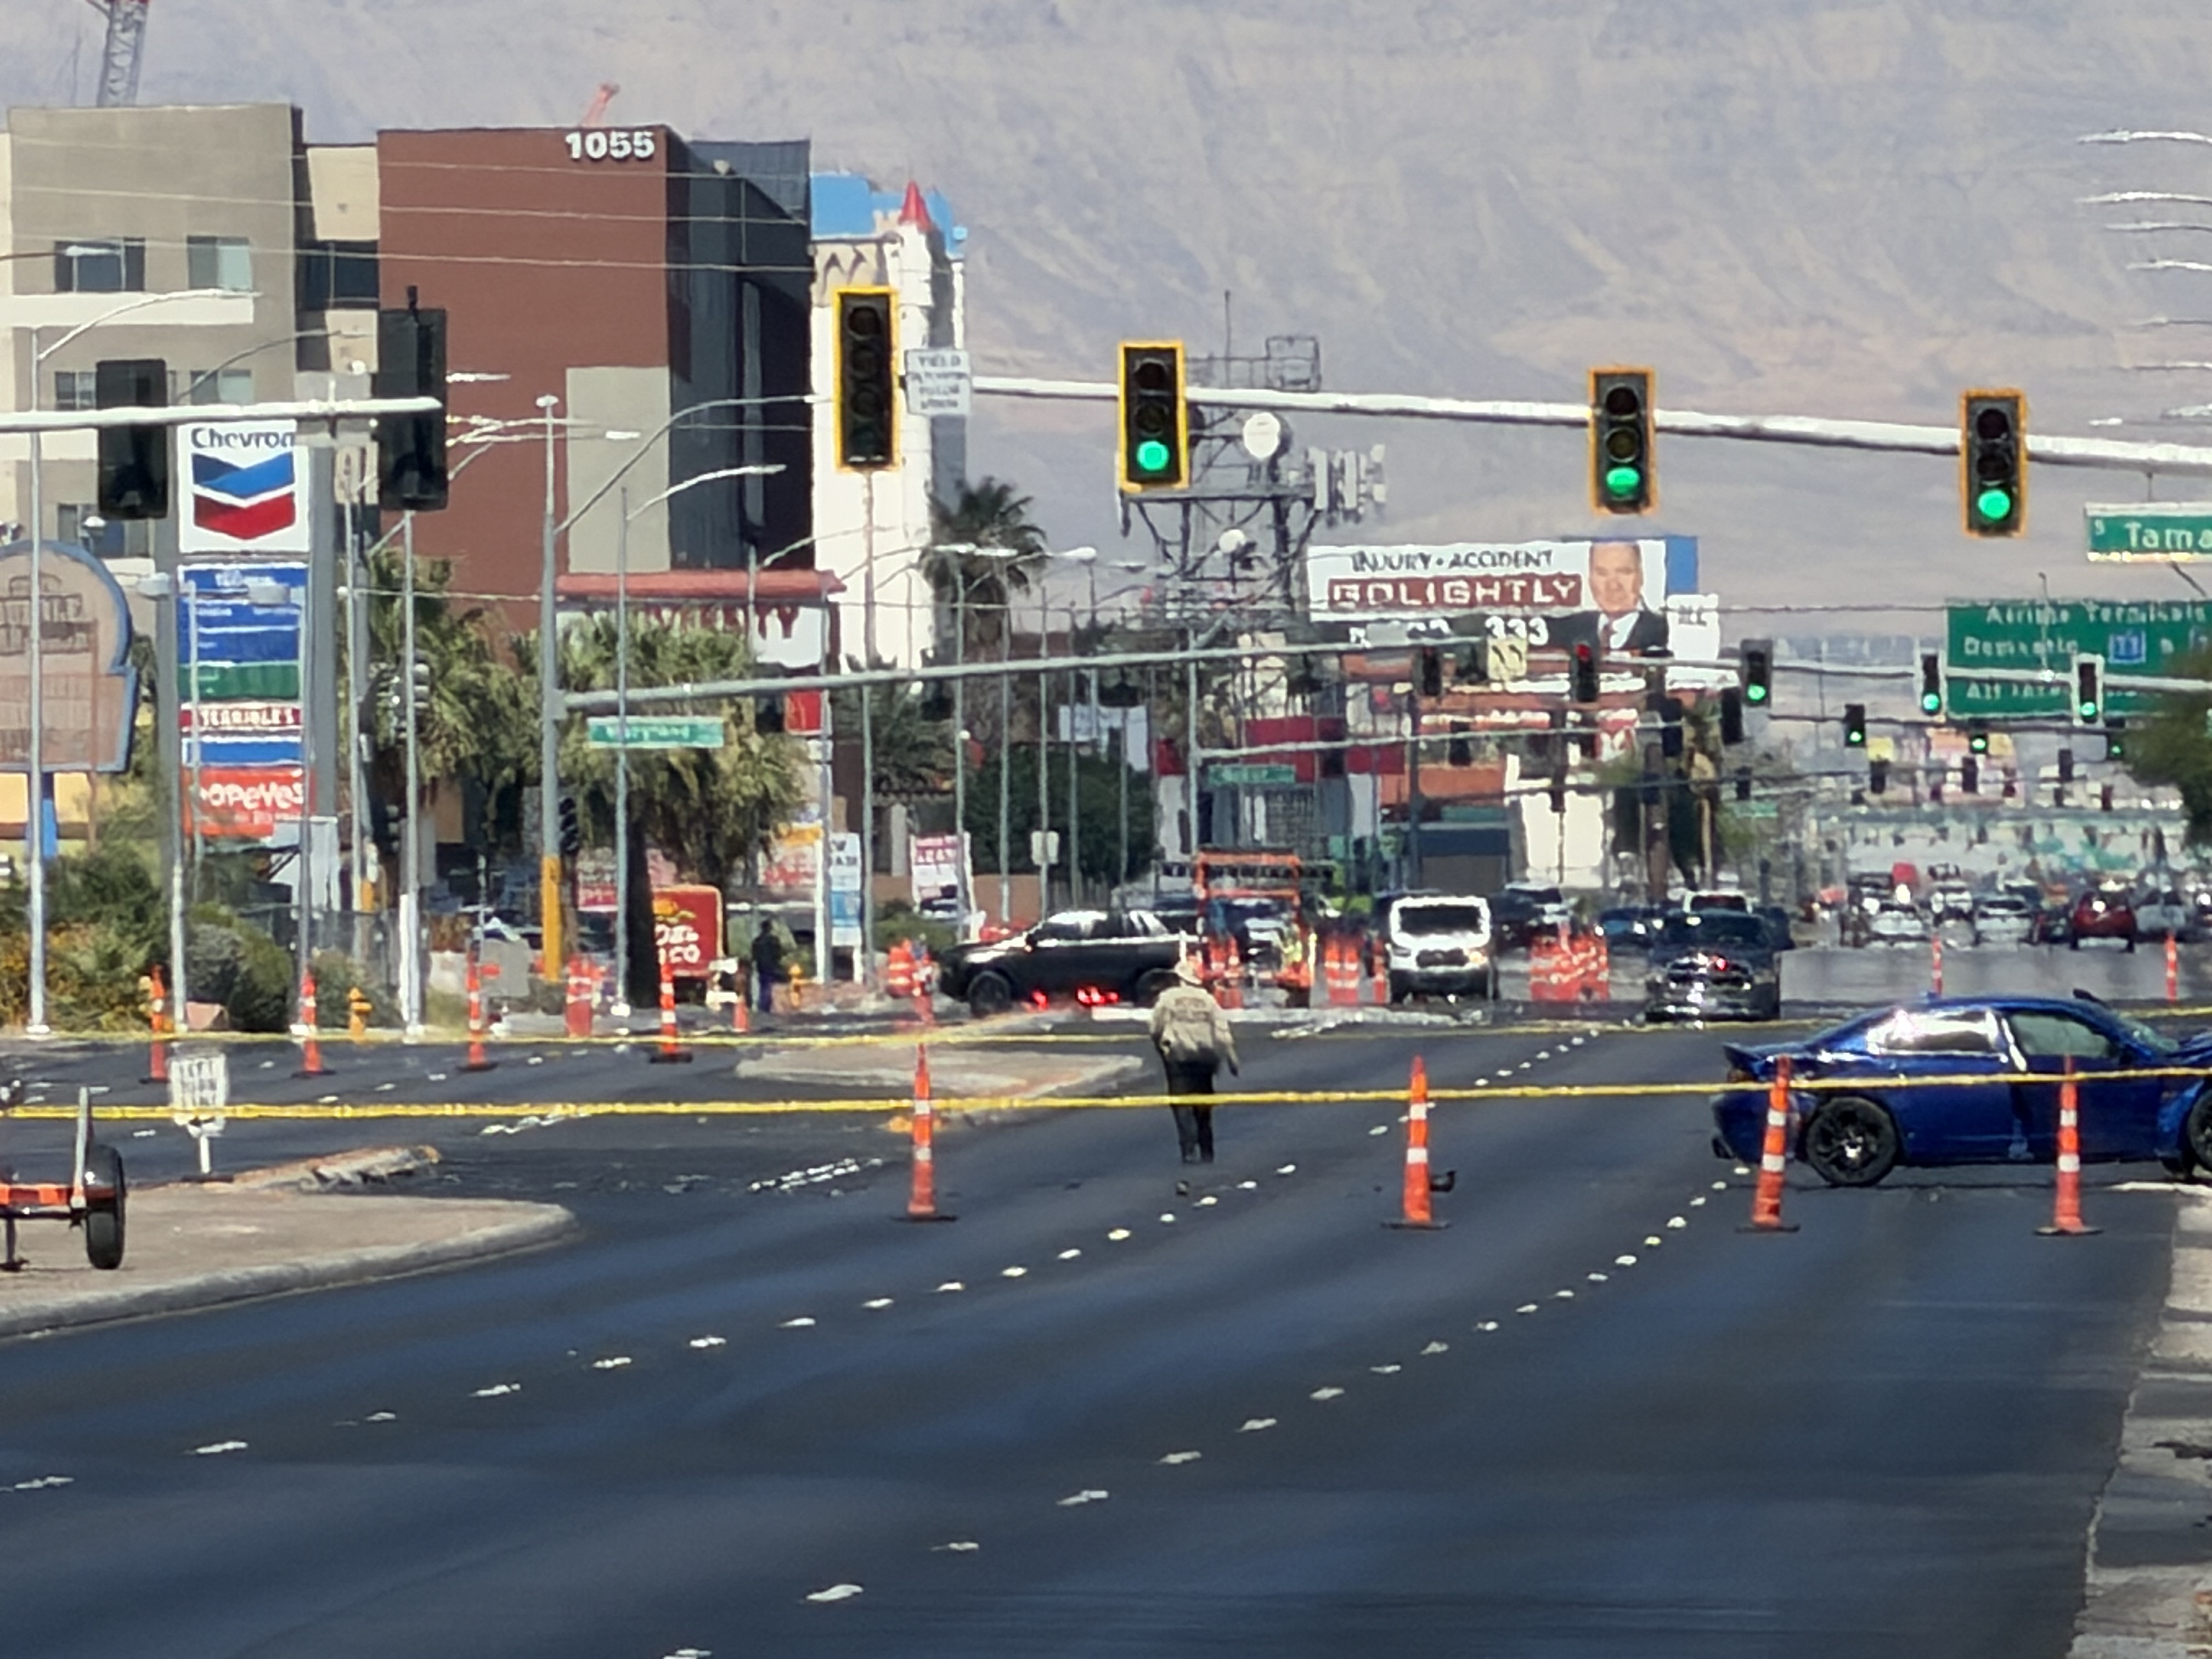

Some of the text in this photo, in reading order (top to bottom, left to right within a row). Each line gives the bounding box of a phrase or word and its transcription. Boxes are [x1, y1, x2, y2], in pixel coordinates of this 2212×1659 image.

[565, 131, 655, 159] 1055
[191, 427, 296, 448] Chevron
[1351, 549, 1553, 572] INJURY ACCIDENT
[1333, 578, 1576, 606] GOLIGHTLY
